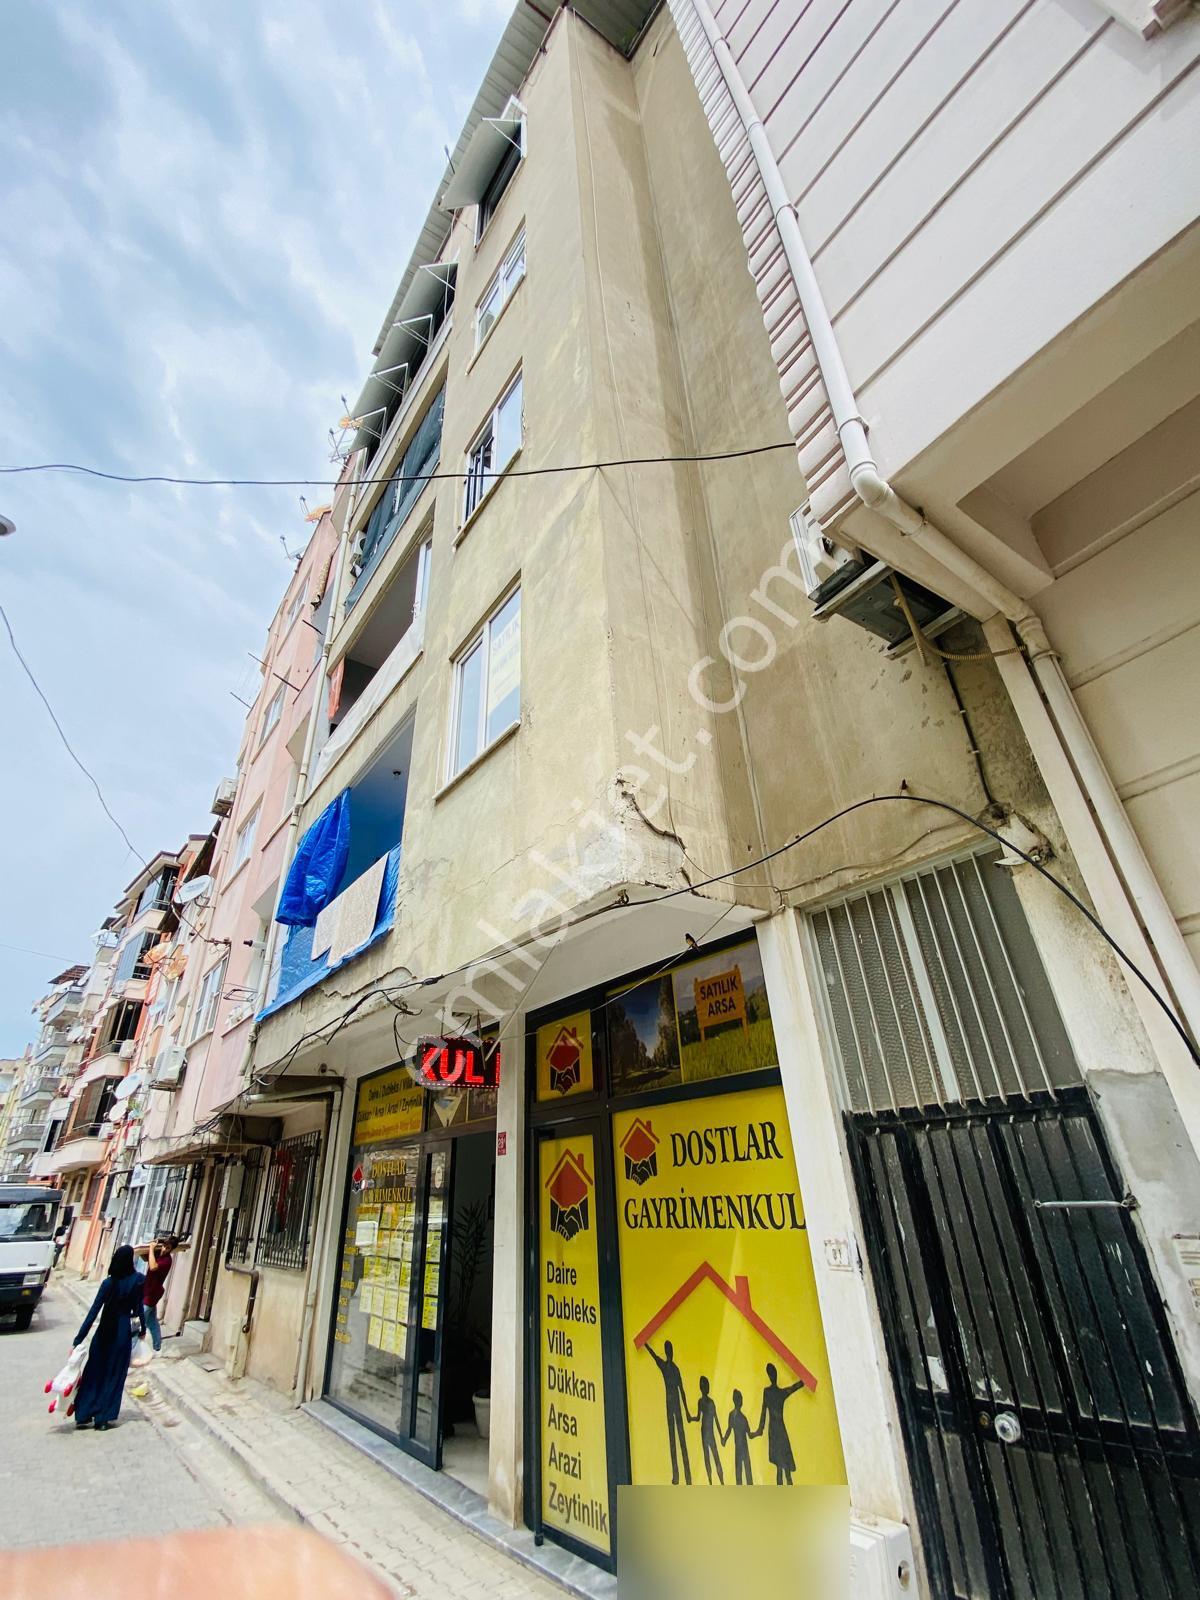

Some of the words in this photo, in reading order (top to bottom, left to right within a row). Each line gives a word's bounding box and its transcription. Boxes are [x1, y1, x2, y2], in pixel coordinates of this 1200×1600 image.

[700, 975, 738, 1001] SATILIK
[707, 996, 737, 1017] ARSA
[670, 1121, 784, 1167] DOSTLAR
[624, 1187, 807, 1230] GAYRİMENKUL
[546, 1261, 577, 1285] Daire
[547, 1295, 597, 1324] Dubleks
[547, 1329, 573, 1357] Villa
[548, 1365, 596, 1402] Dükkan
[548, 1403, 578, 1437] Arsa
[548, 1442, 582, 1480] Arazi
[549, 1482, 608, 1535] Zeytinlik
